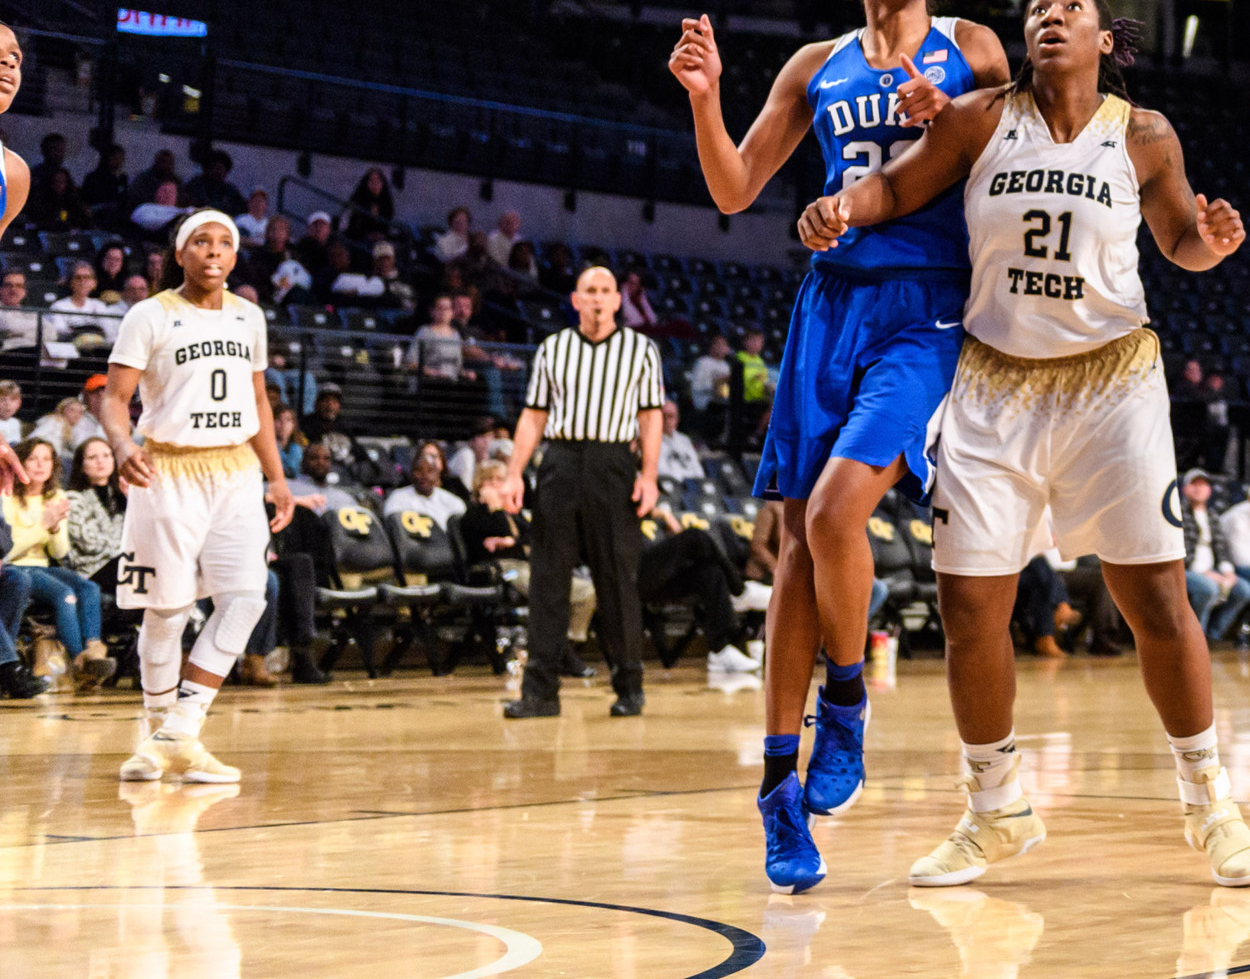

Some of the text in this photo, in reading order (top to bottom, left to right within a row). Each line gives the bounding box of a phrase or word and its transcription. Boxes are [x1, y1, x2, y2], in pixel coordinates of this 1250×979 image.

[826, 92, 926, 137] DUK
[842, 140, 917, 190] 2
[988, 169, 1113, 209] GEORGIA
[1022, 209, 1074, 263] 21
[1007, 268, 1086, 301] TECH
[175, 339, 252, 366] GEORGIA
[211, 368, 227, 401] 0
[190, 411, 242, 429] TECH
